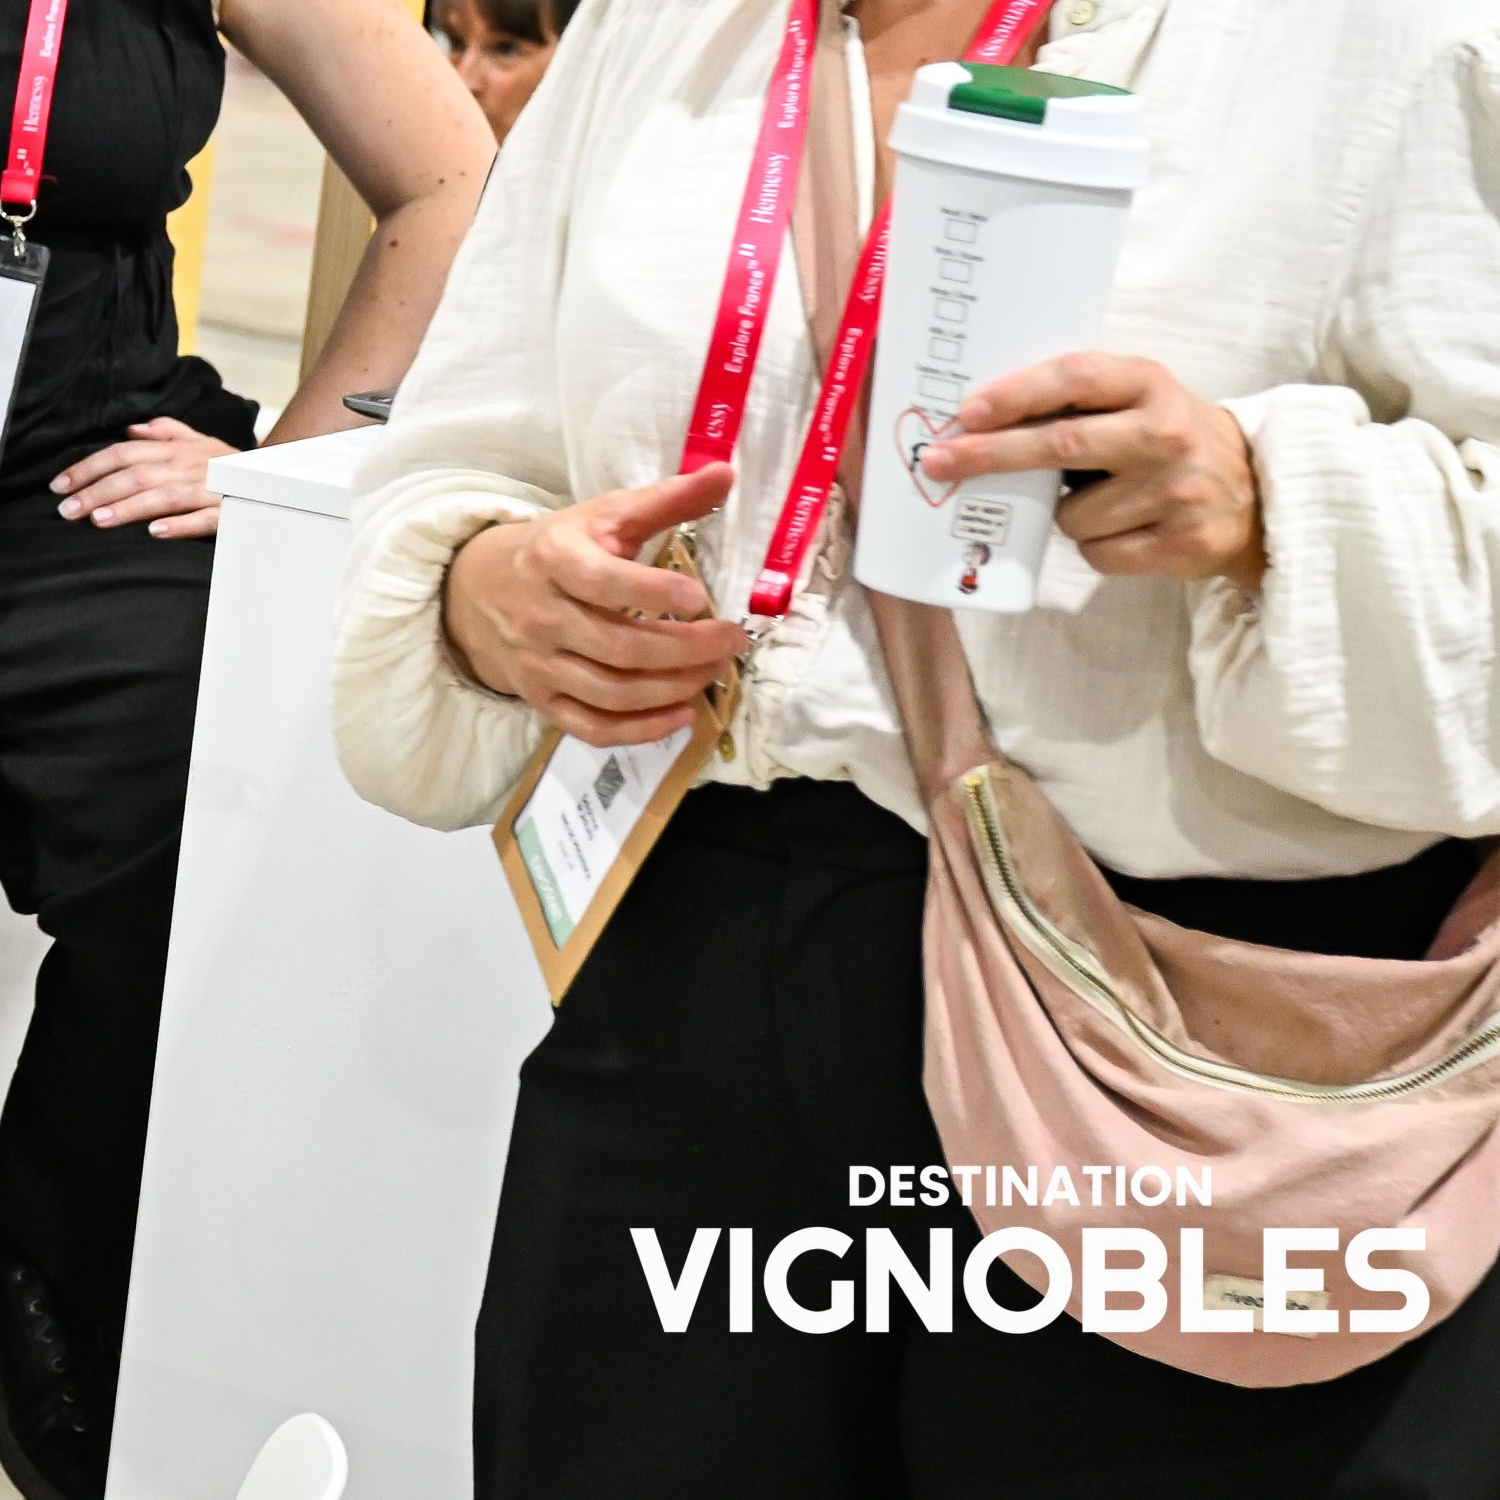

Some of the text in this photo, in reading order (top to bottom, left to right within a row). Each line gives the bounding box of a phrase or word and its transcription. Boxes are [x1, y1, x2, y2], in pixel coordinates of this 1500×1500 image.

[748, 152, 791, 225] Hennessy
[723, 318, 755, 374] Explore
[834, 326, 864, 382] Explore
[775, 484, 823, 565] Hennessy
